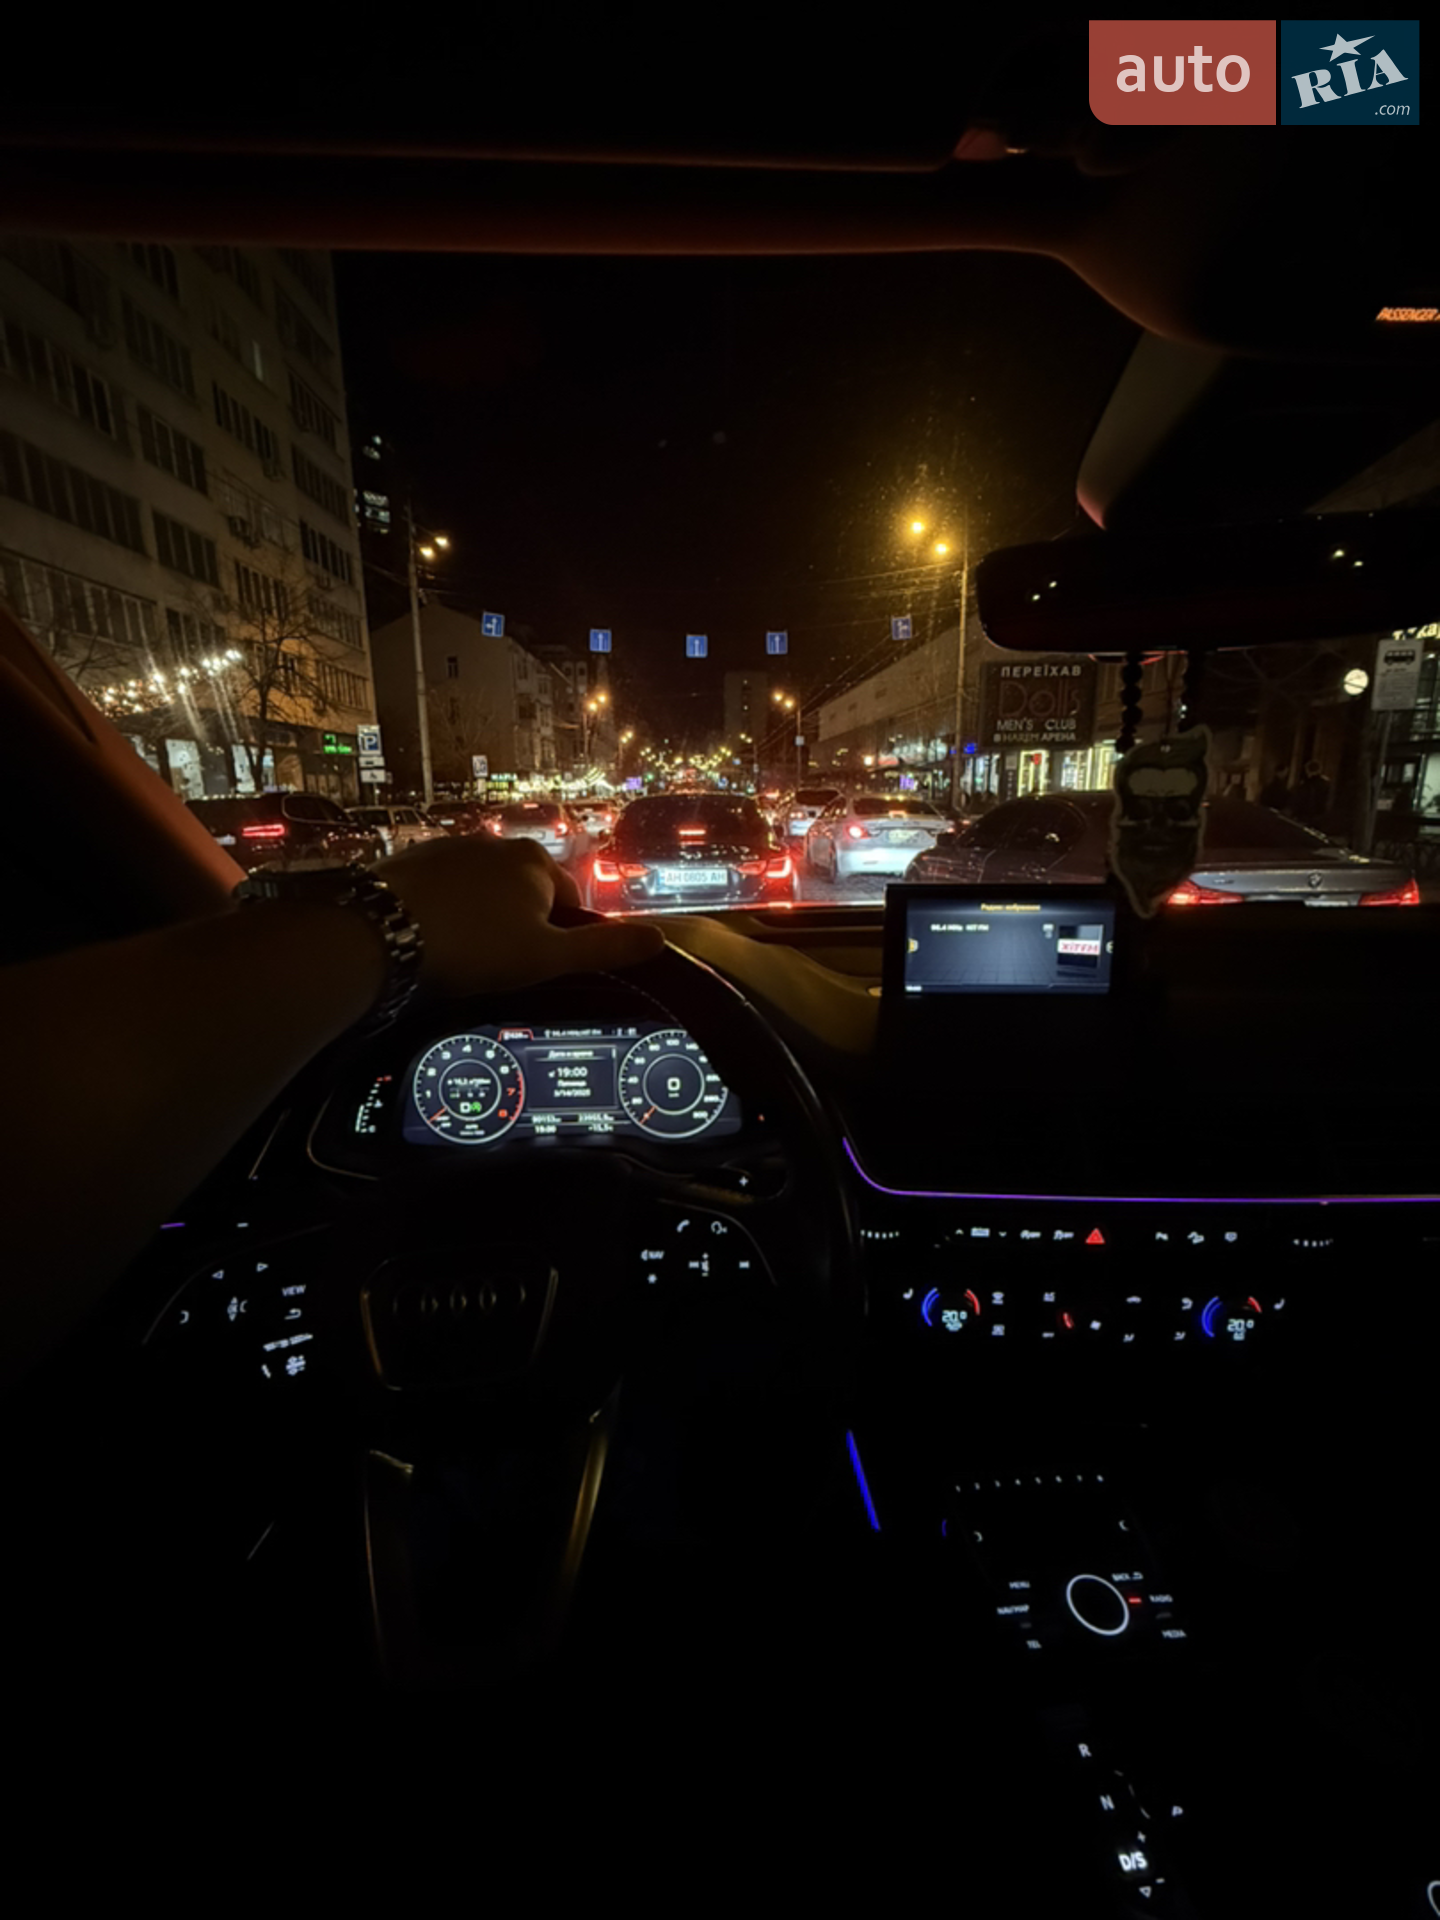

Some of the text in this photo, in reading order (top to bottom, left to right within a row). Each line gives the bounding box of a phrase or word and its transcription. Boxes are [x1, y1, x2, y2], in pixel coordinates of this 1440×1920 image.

[1001, 664, 1082, 678] ПЕРЕЇХАВ
[996, 718, 1077, 731] MEN'S CLUB
[365, 733, 377, 750] P
[462, 1044, 472, 1053] 4
[557, 1066, 588, 1078] 19:00
[507, 1088, 516, 1096] 7
[282, 1285, 306, 1296] VIEW
[1009, 1581, 1031, 1589] MENU
[1149, 1595, 1173, 1603] RADIO
[1162, 1629, 1187, 1638] MEDIA
[1026, 1640, 1042, 1649] TEL
[1078, 1743, 1092, 1757] R
[1100, 1795, 1115, 1810] N
[1172, 1805, 1184, 1816] P
[1118, 1850, 1148, 1872] D/S
